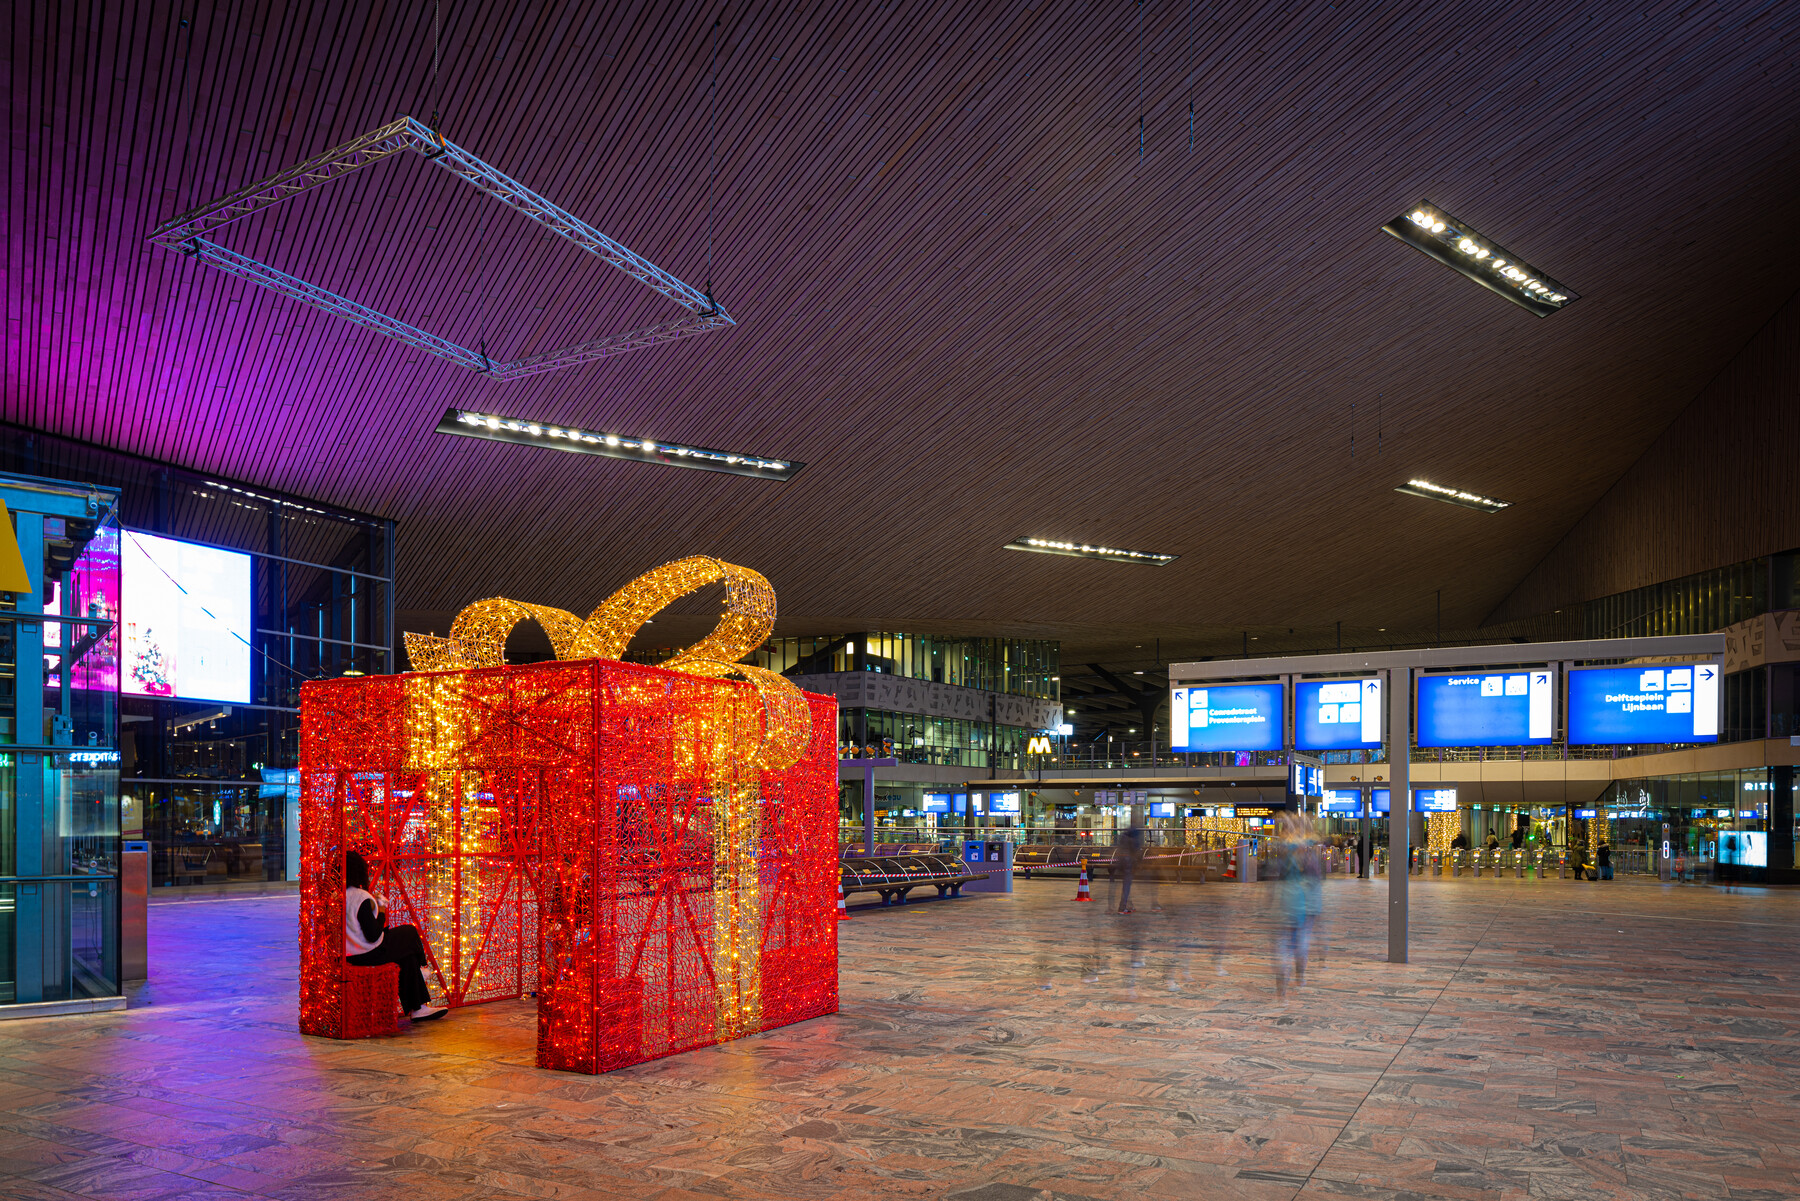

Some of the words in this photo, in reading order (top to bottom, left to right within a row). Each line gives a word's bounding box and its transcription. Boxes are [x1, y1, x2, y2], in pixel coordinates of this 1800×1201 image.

[1448, 677, 1480, 686] Service
[1605, 693, 1664, 703] Delftseplein
[1622, 703, 1664, 713] Lijnbaan
